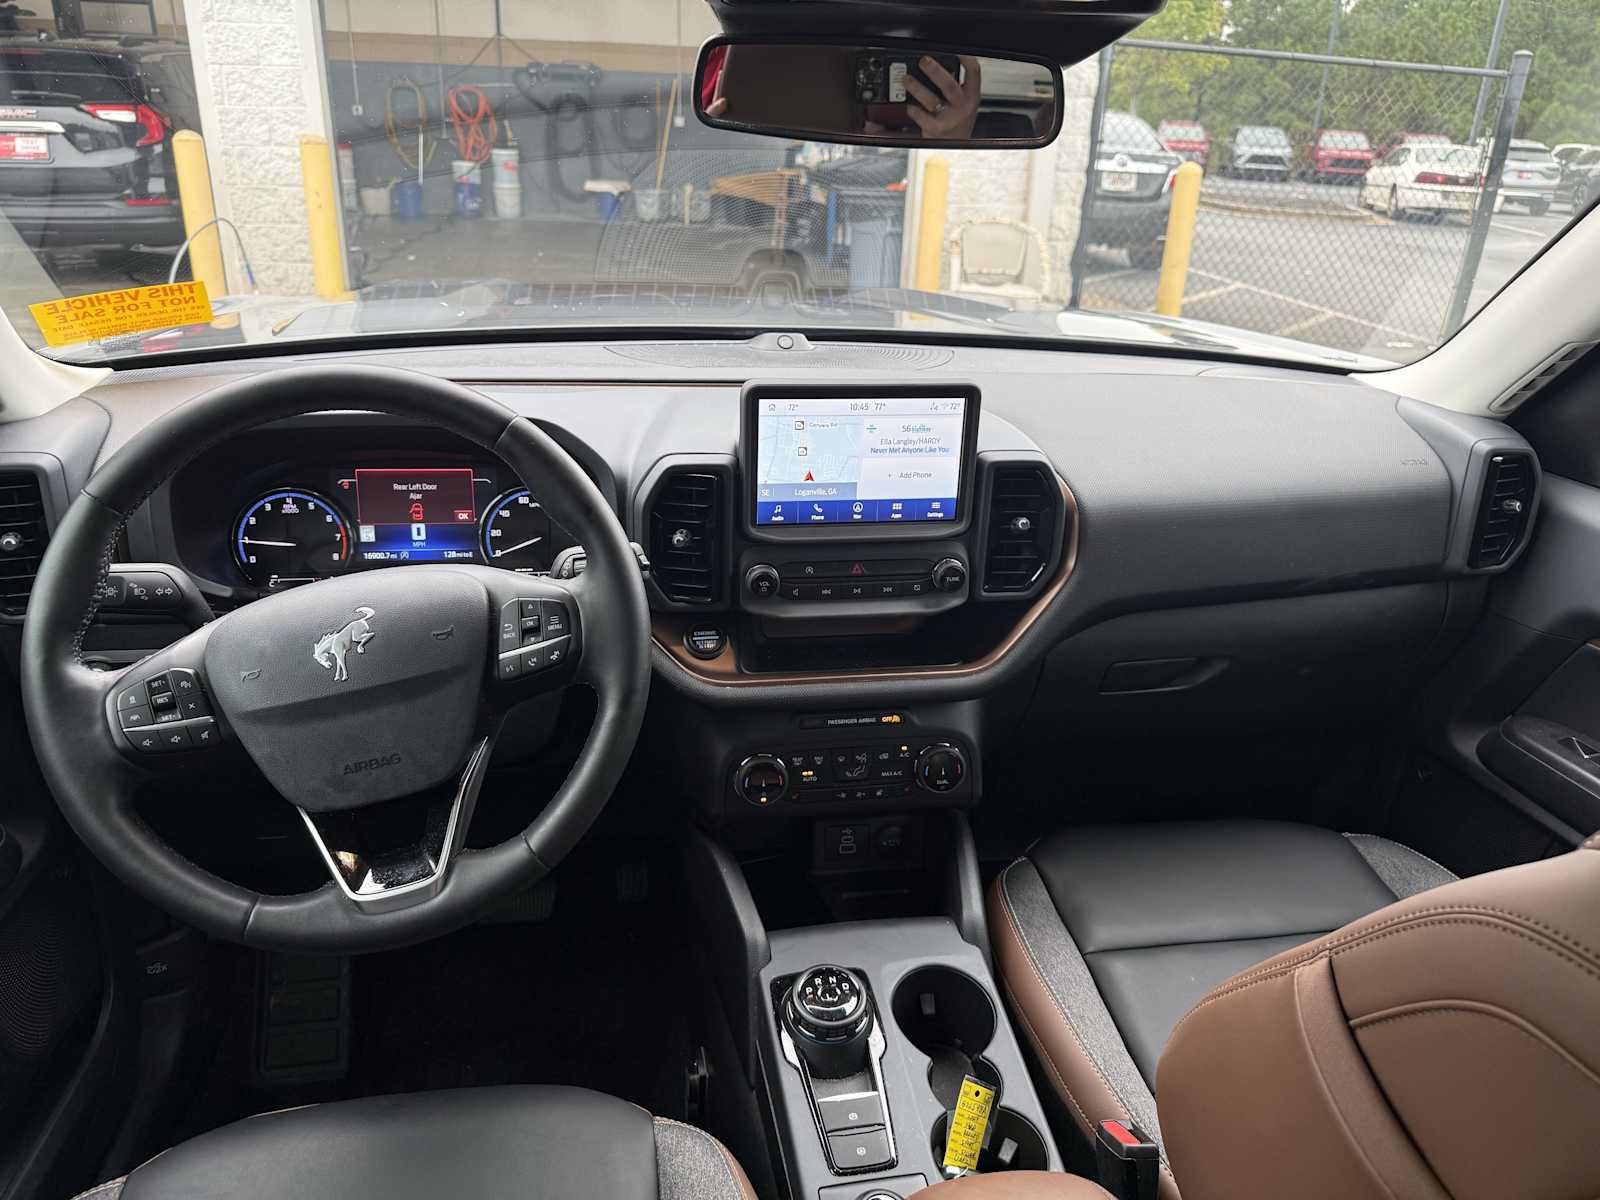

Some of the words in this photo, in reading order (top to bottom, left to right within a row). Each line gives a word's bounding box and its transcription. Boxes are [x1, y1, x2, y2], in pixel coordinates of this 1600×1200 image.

[901, 447, 924, 455] Anyone
[912, 471, 932, 479] Phone
[308, 502, 315, 510] 5
[249, 517, 257, 525] 2
[335, 533, 341, 541] 7
[343, 754, 402, 775] AIRBAG
[814, 977, 822, 986] R
[829, 976, 837, 984] N
[842, 983, 850, 991] D
